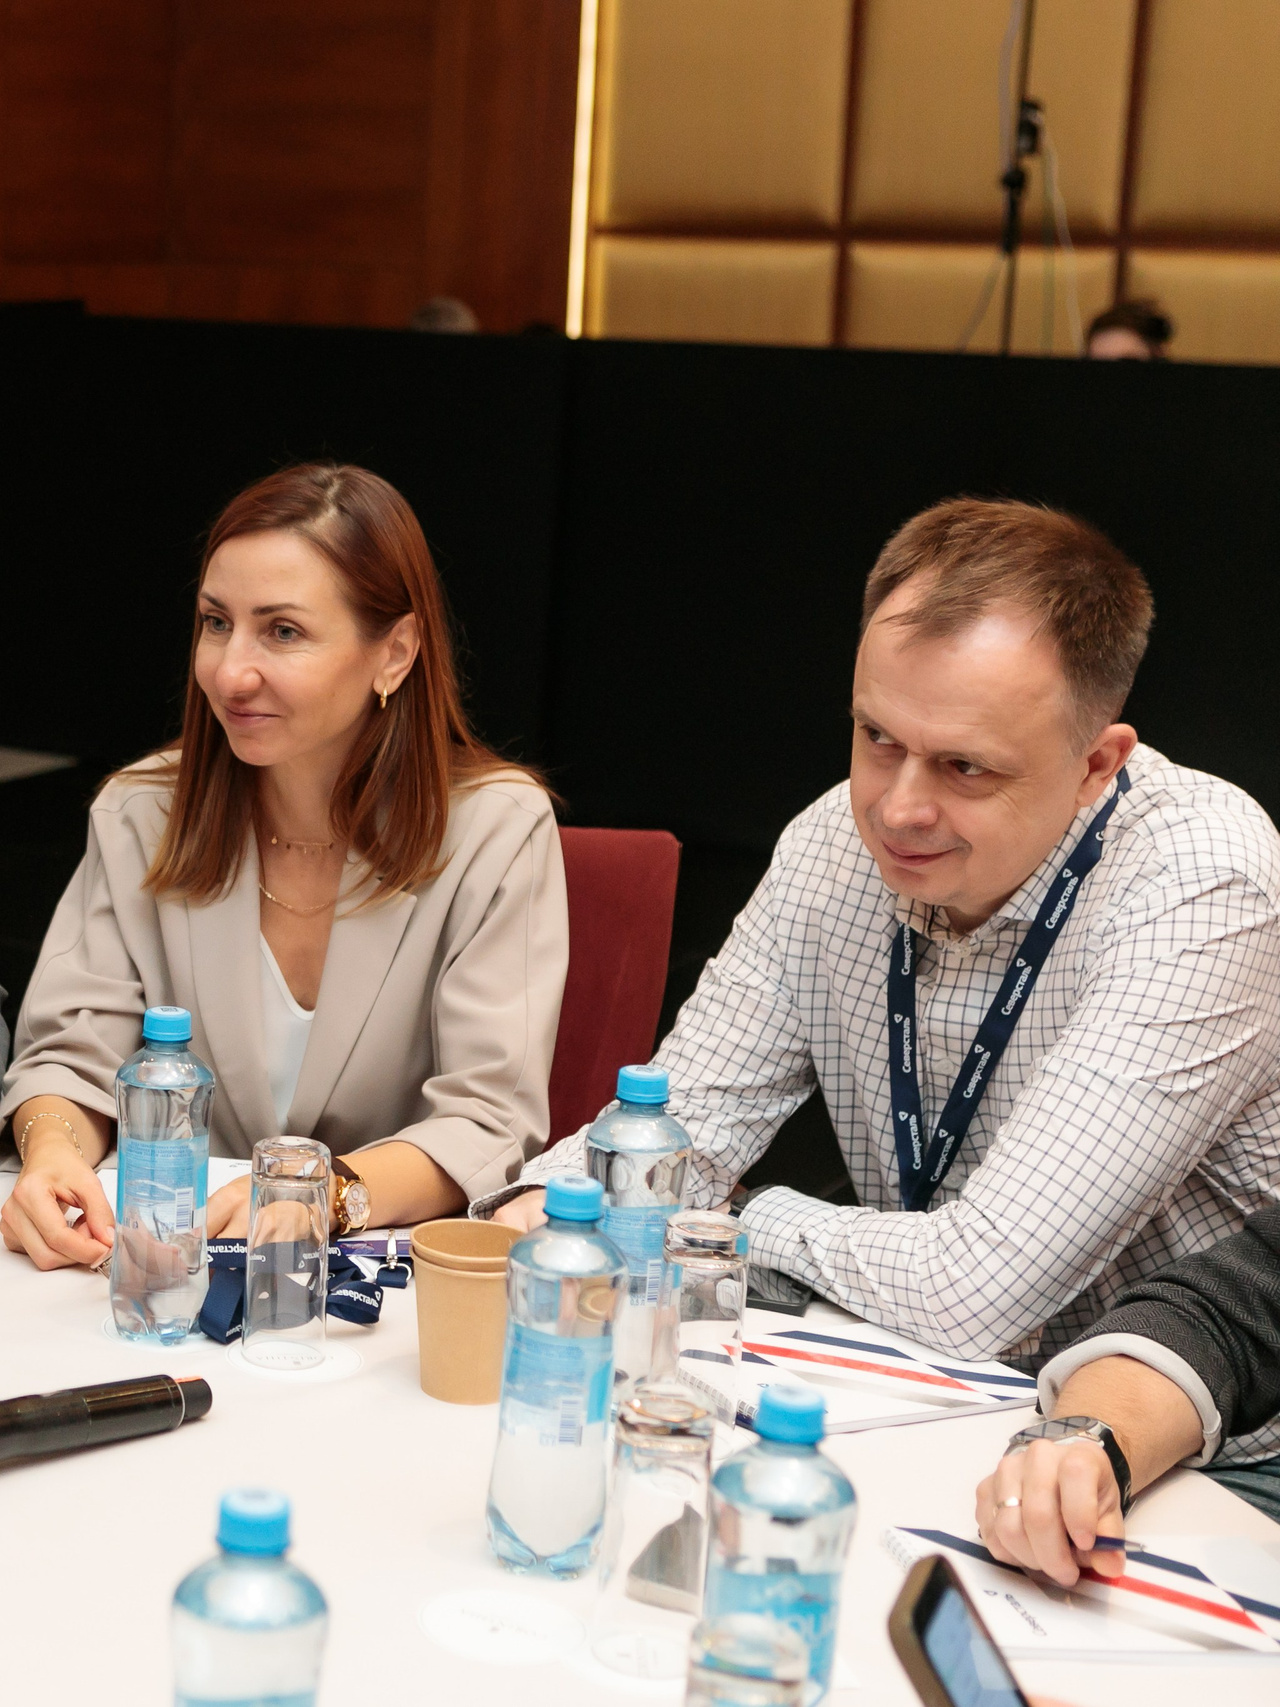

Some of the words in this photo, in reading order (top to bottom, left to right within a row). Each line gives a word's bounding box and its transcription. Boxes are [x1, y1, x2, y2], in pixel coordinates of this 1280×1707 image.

[1044, 876, 1079, 930] Северсталь
[901, 924, 913, 976] Северстал
[1000, 965, 1033, 1016] Северсталь
[901, 1016, 912, 1074] Северсталь
[962, 1050, 991, 1099] Северсталь
[908, 1113, 923, 1170] Северсталь
[929, 1134, 955, 1182] Северсталь
